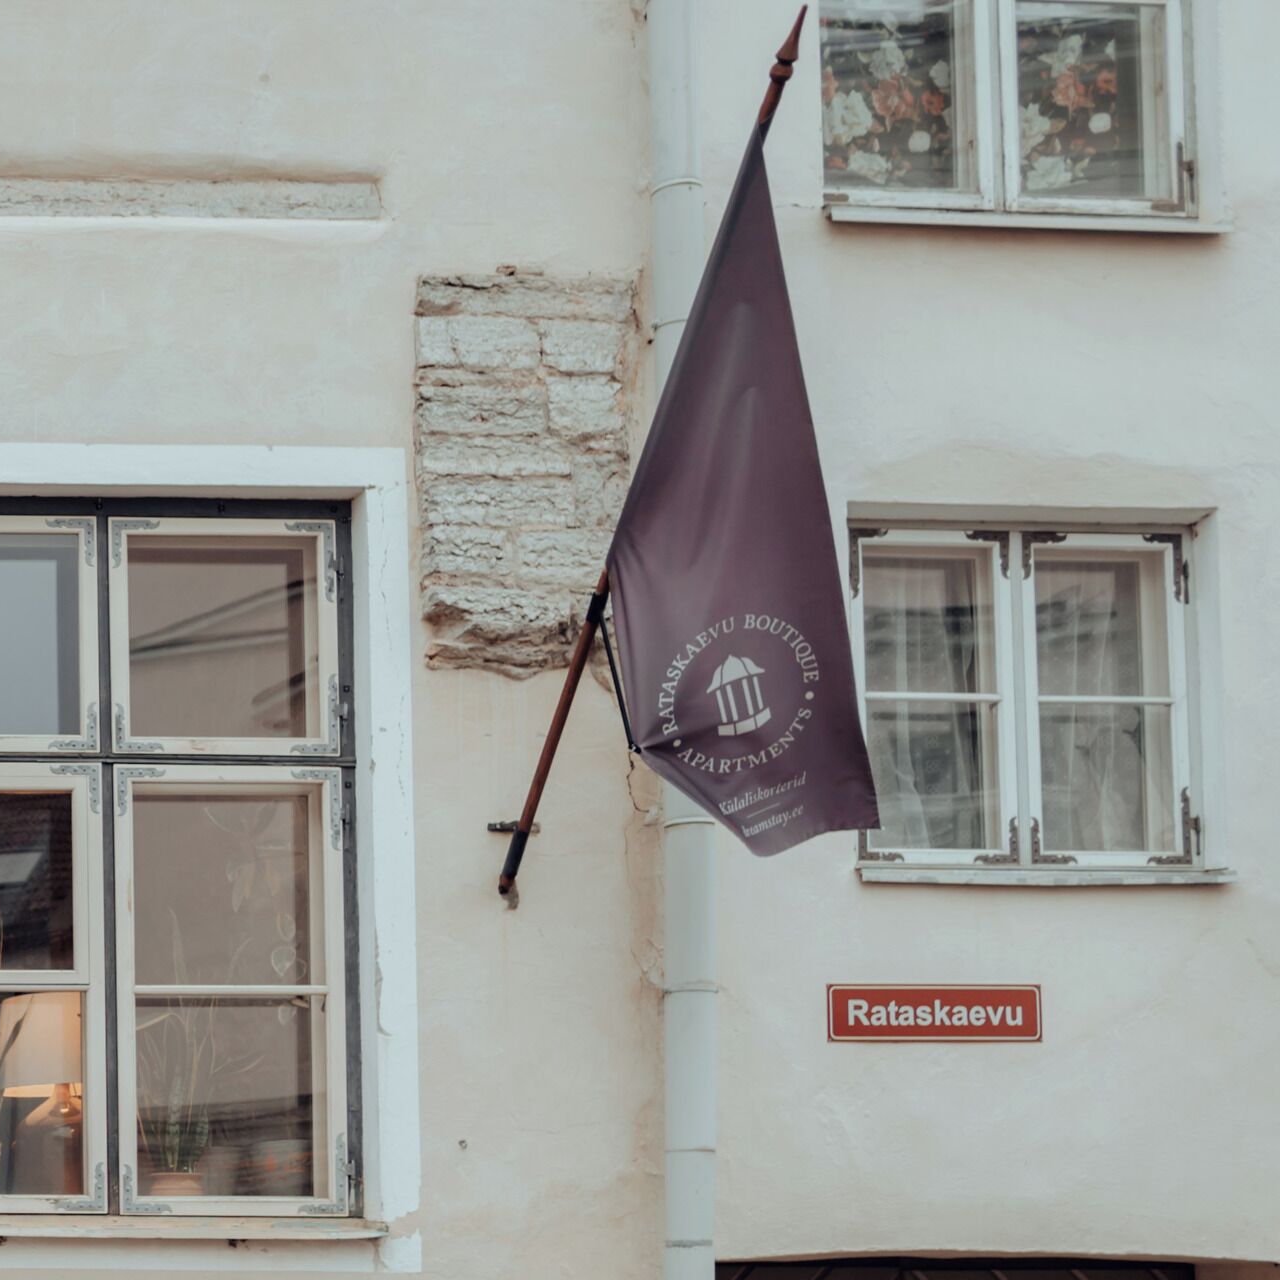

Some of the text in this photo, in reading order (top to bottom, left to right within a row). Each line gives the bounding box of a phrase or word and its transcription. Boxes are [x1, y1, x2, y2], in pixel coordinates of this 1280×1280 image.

[657, 613, 819, 737] RATASKAEVU BOUTIQUE
[677, 707, 812, 775] APARTMENTS
[718, 770, 807, 816] Külaliskorterid
[847, 998, 1024, 1027] Rataskaevu
